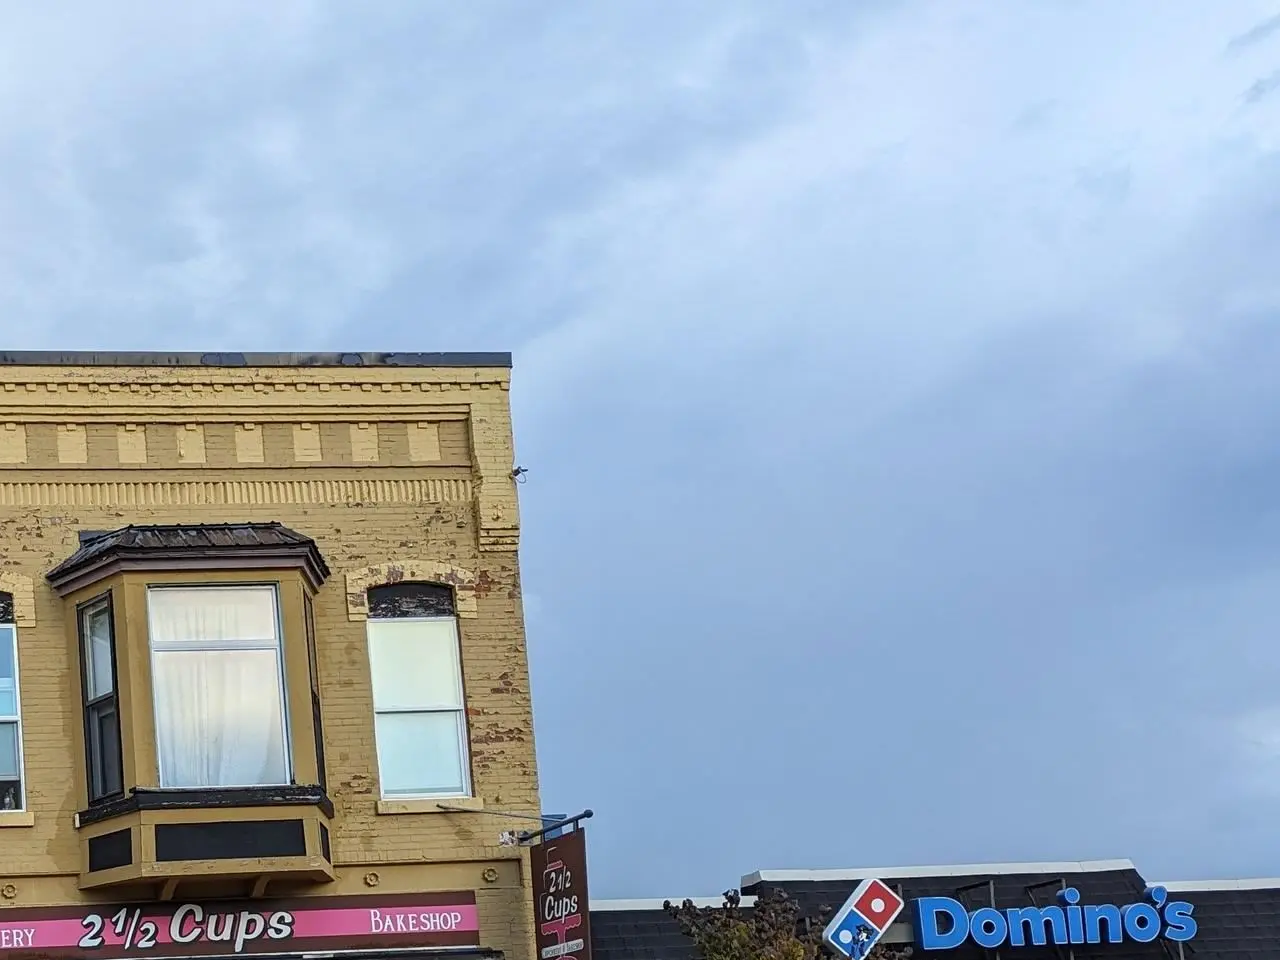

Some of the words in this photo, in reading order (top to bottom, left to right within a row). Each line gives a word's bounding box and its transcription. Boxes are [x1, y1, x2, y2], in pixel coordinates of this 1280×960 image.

[170, 903, 292, 953] Cups
[370, 909, 461, 933] BAKESHOP
[544, 895, 578, 924] Cups
[916, 886, 1198, 950] Domino's
